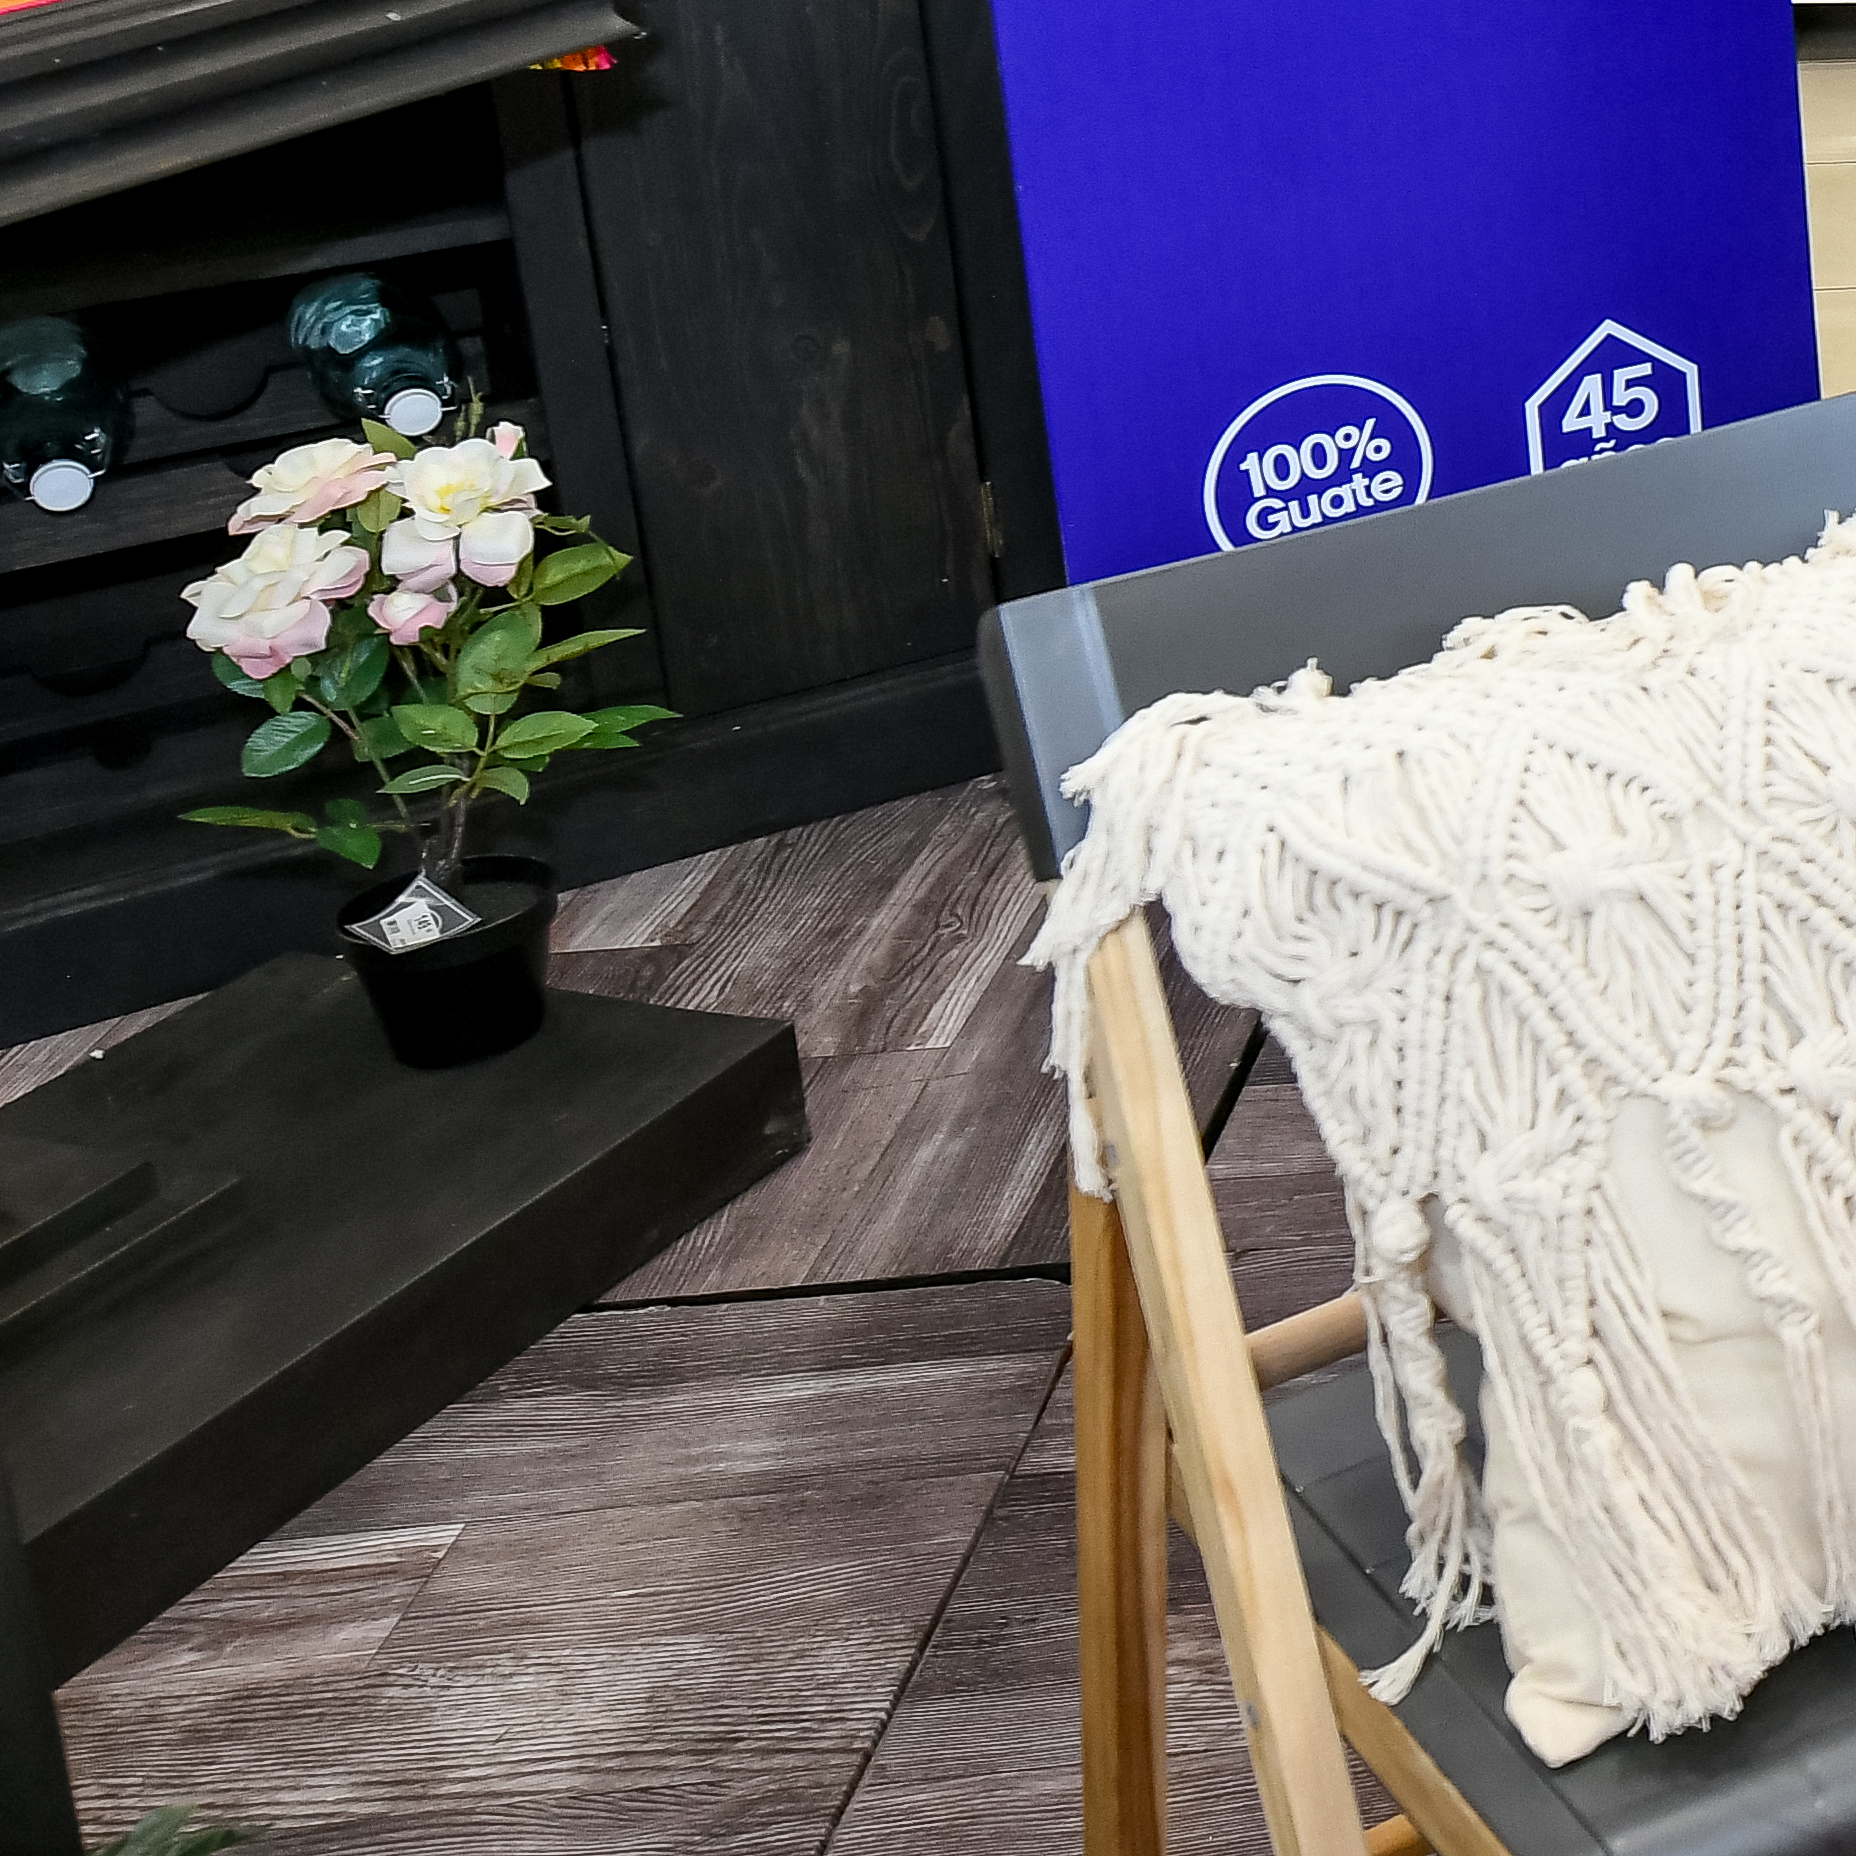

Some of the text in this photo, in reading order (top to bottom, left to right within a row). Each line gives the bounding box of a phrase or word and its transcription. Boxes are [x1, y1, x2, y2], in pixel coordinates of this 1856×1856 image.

[1561, 362, 1659, 439] 45
[1239, 417, 1391, 498] 100%
[1245, 470, 1404, 540] Guate
